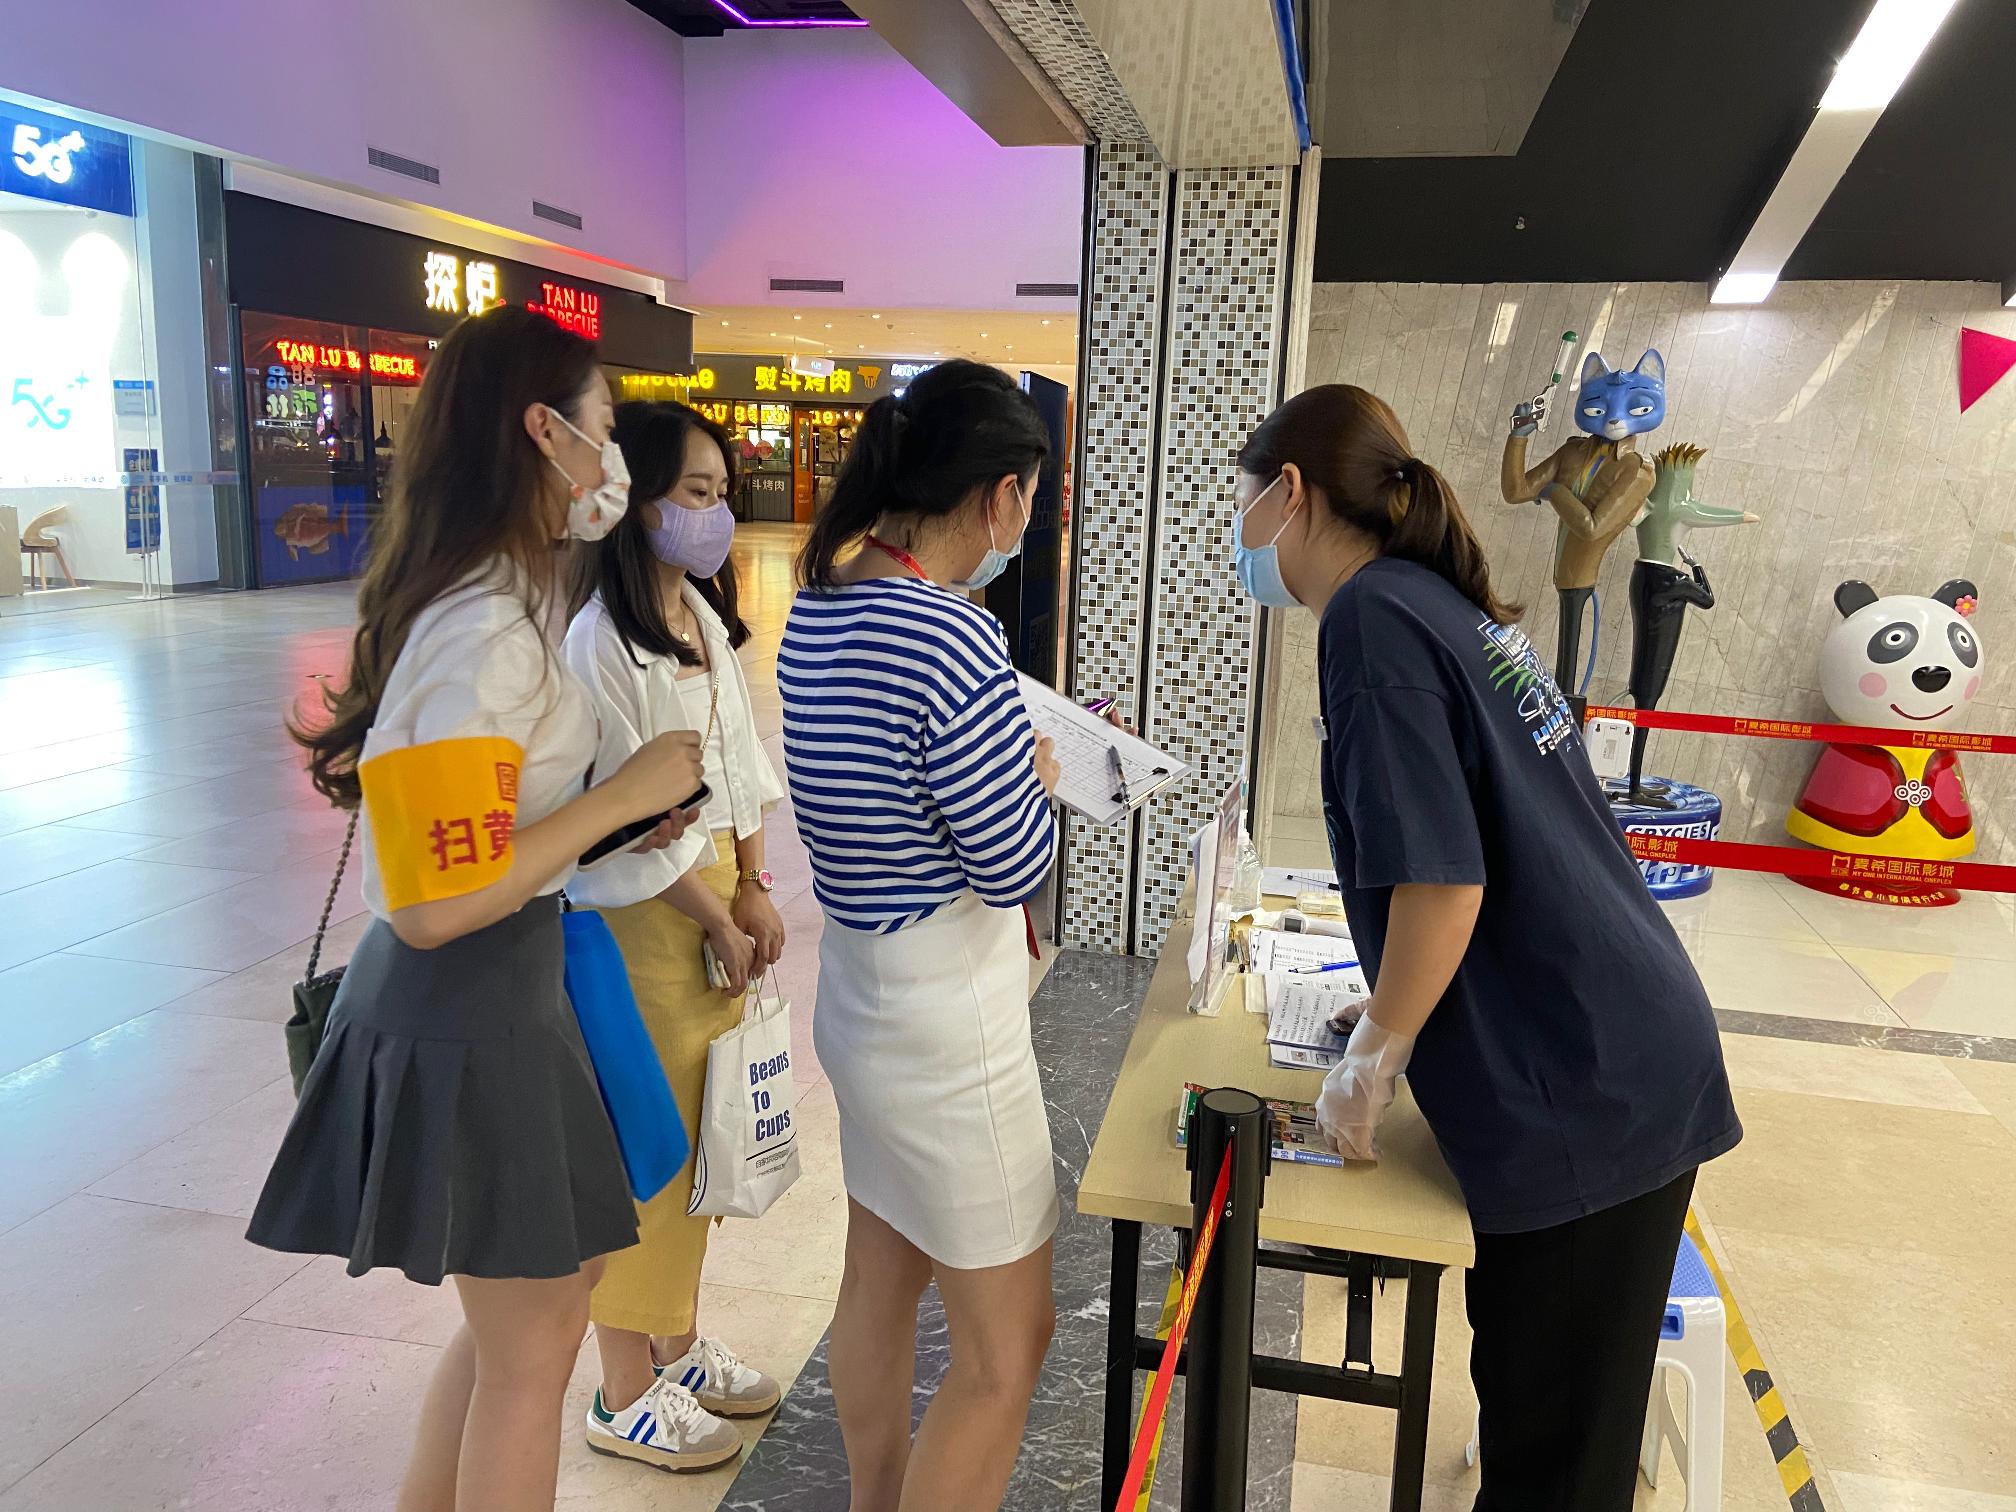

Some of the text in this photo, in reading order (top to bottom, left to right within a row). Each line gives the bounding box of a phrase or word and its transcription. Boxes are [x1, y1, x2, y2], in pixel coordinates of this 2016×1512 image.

[543, 282, 599, 315] TAN LU
[276, 342, 315, 364] TAN
[320, 346, 341, 367] LU
[749, 1050, 790, 1086] Beans
[751, 1090, 771, 1114] To
[755, 1109, 791, 1142] Cups
